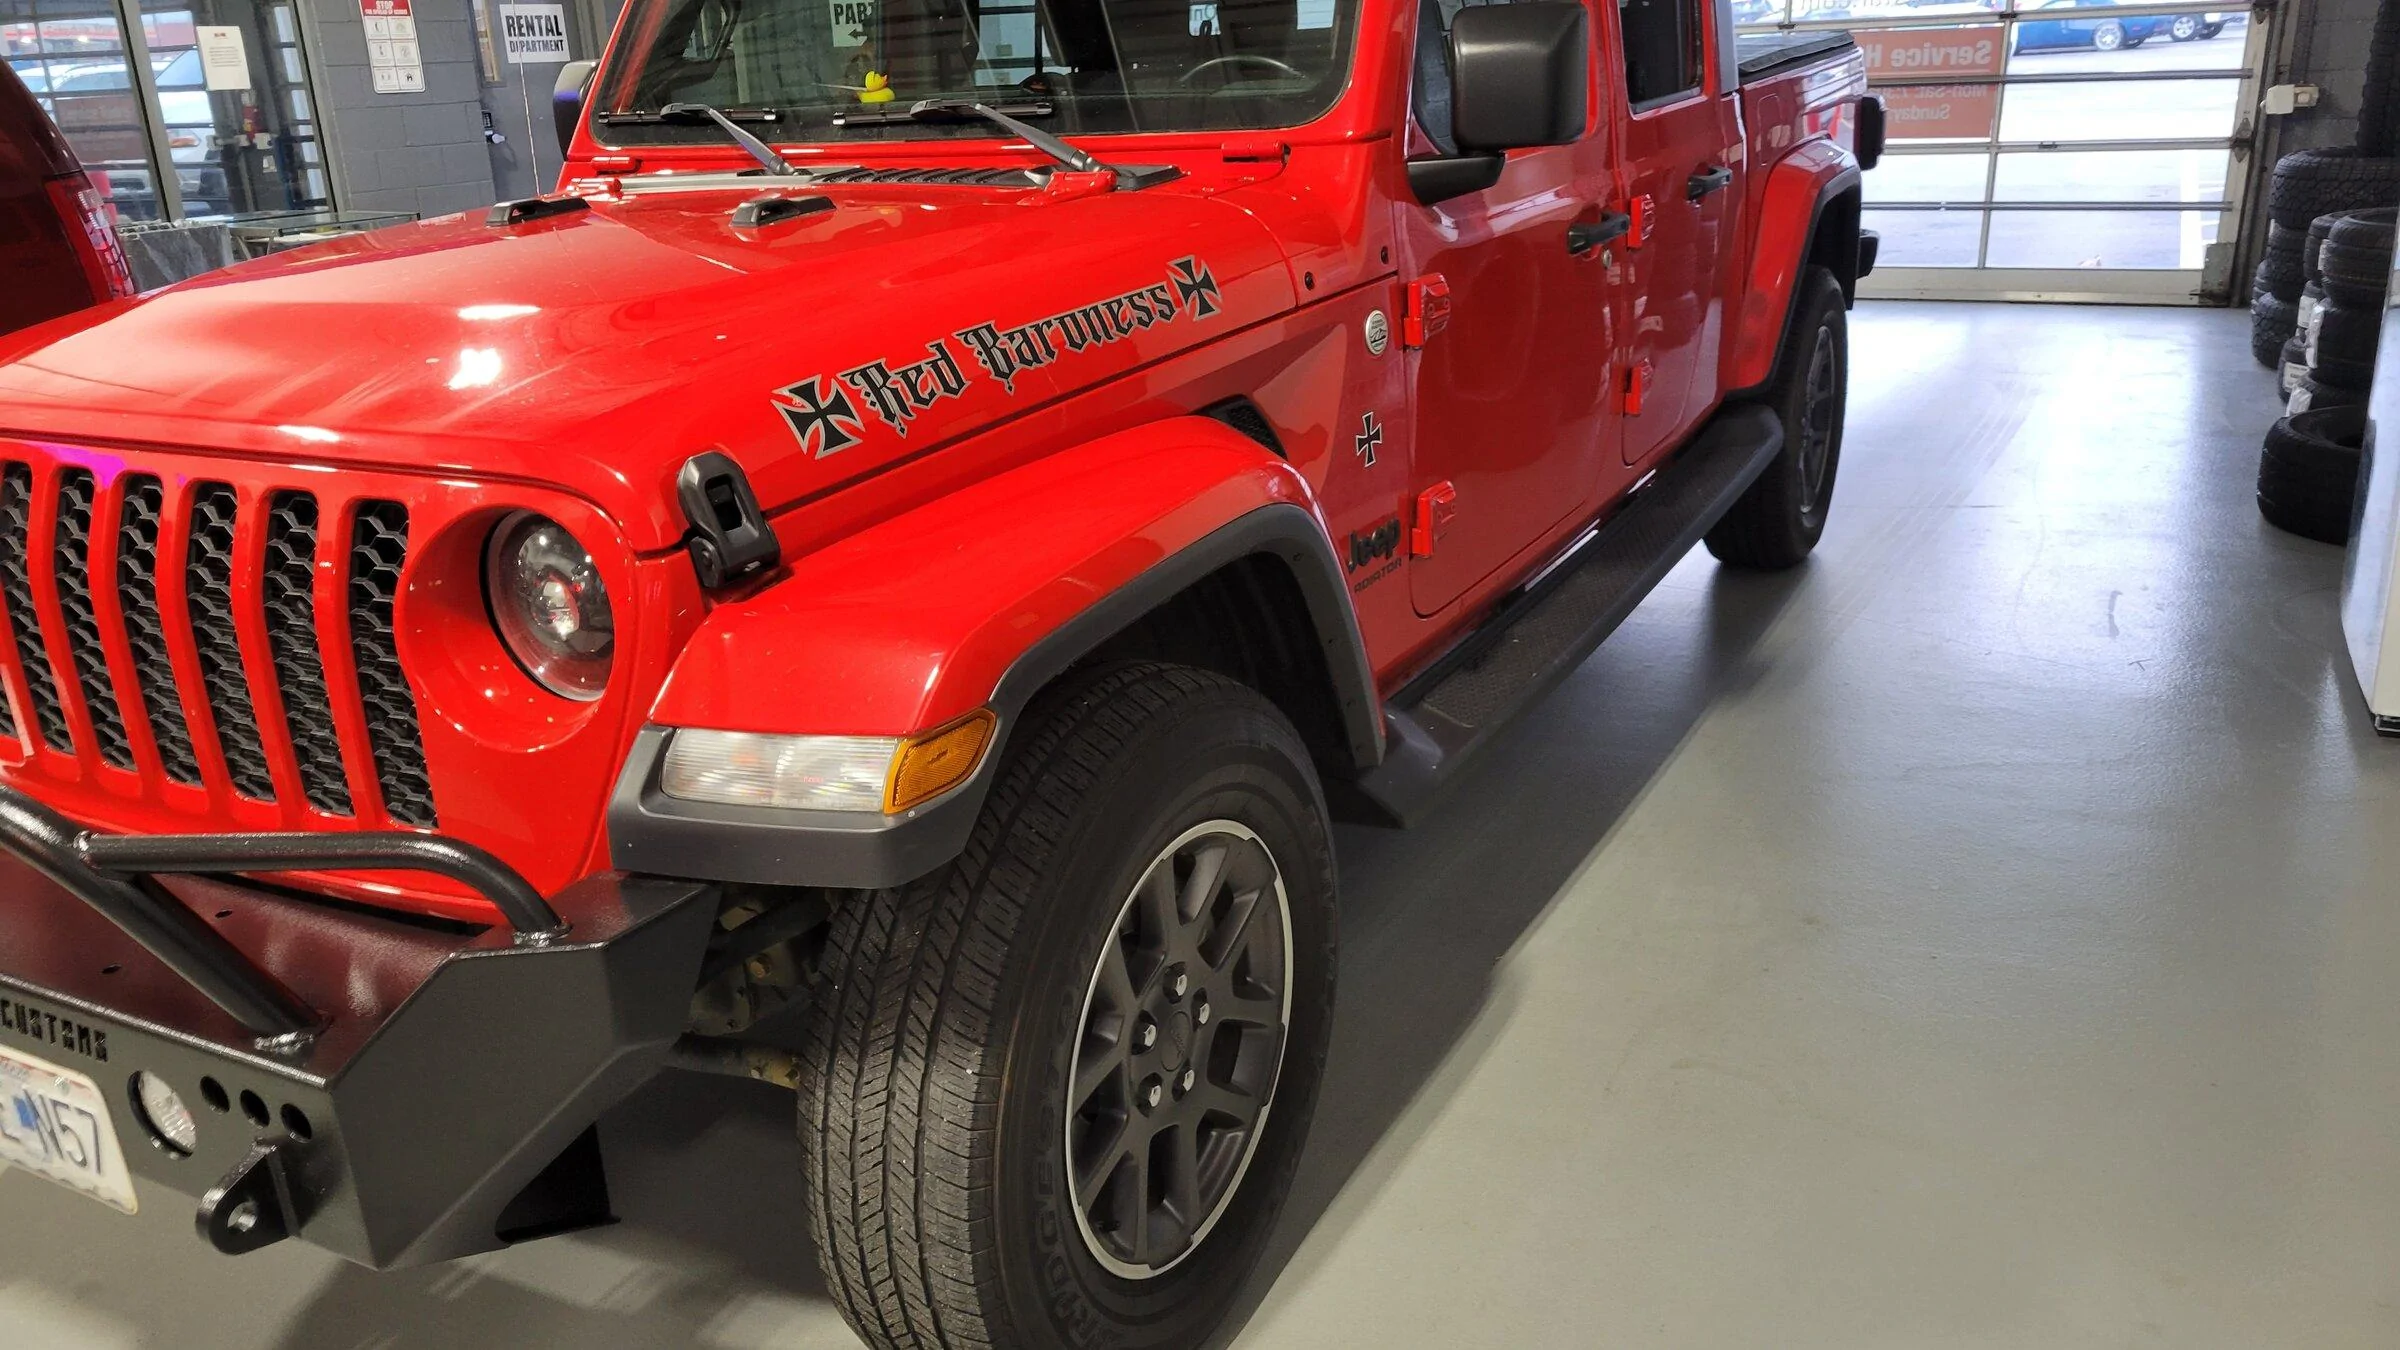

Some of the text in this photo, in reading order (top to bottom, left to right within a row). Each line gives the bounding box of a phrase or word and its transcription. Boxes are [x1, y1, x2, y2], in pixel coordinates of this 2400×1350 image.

[505, 14, 562, 37] RENTAL
[837, 281, 1178, 438] Red Baroness
[1348, 518, 1401, 575] Jeep
